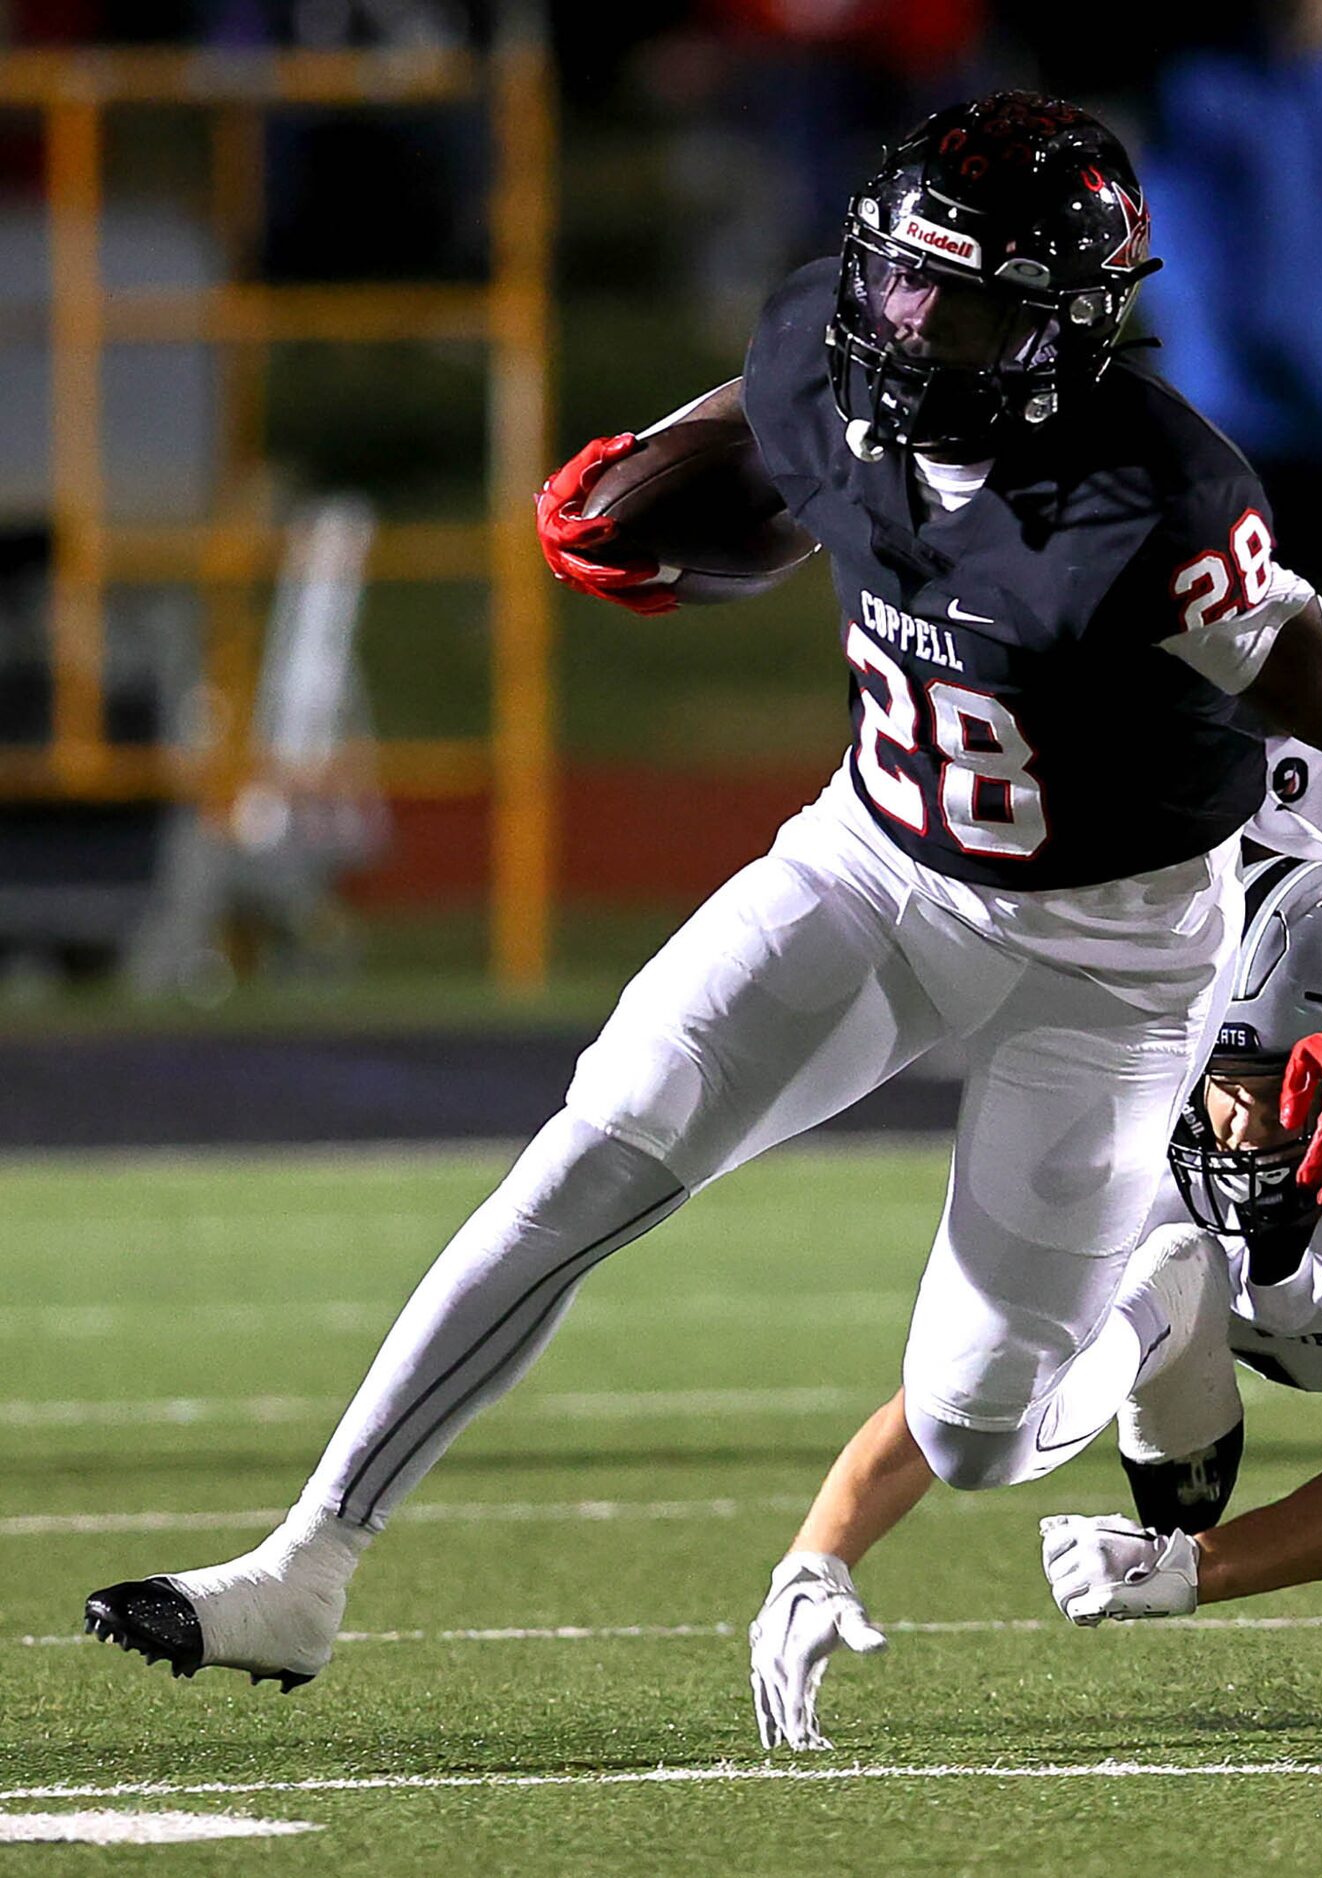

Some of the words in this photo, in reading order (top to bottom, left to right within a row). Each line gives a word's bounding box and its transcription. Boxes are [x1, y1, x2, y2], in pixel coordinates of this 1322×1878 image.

[906, 221, 974, 259] Riddell
[1168, 508, 1278, 632] 28
[860, 589, 964, 672] COPPELL
[845, 619, 1050, 862] 28
[1216, 1028, 1246, 1047] ATS
